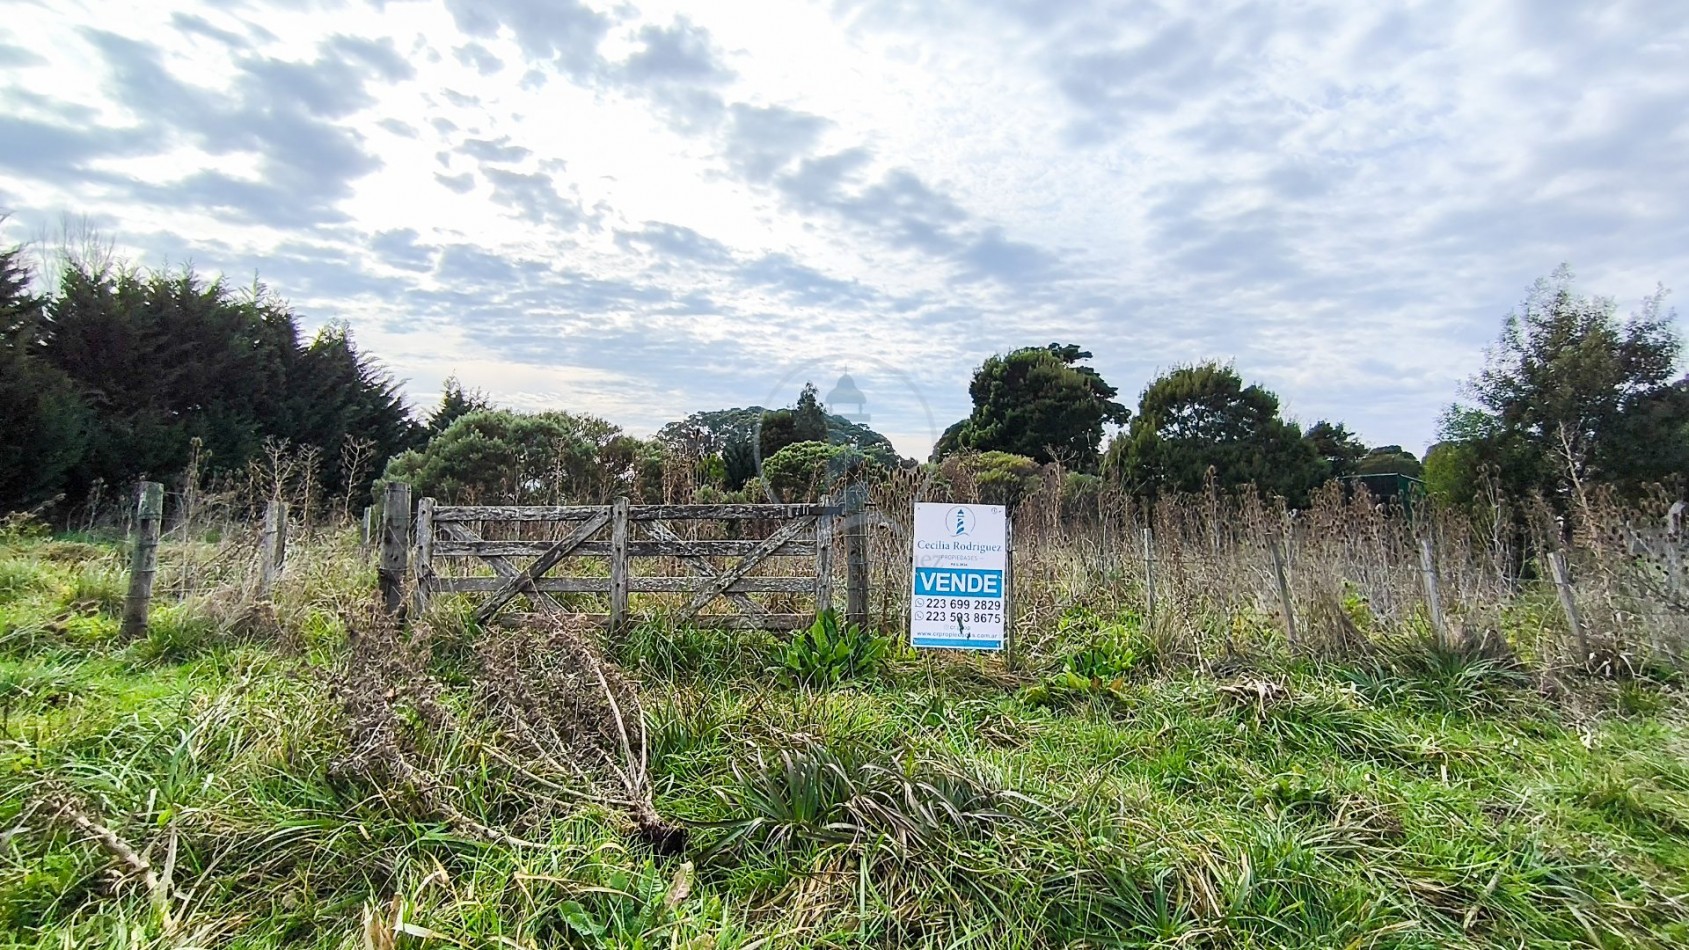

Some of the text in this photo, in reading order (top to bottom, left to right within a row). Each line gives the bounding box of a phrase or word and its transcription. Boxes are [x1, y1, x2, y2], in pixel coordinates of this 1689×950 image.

[917, 540, 950, 550] Cecilia
[920, 572, 998, 593] VENDE
[926, 598, 1000, 611] 223 699 2829
[925, 611, 946, 622] 223
[974, 613, 1001, 624] 8675
